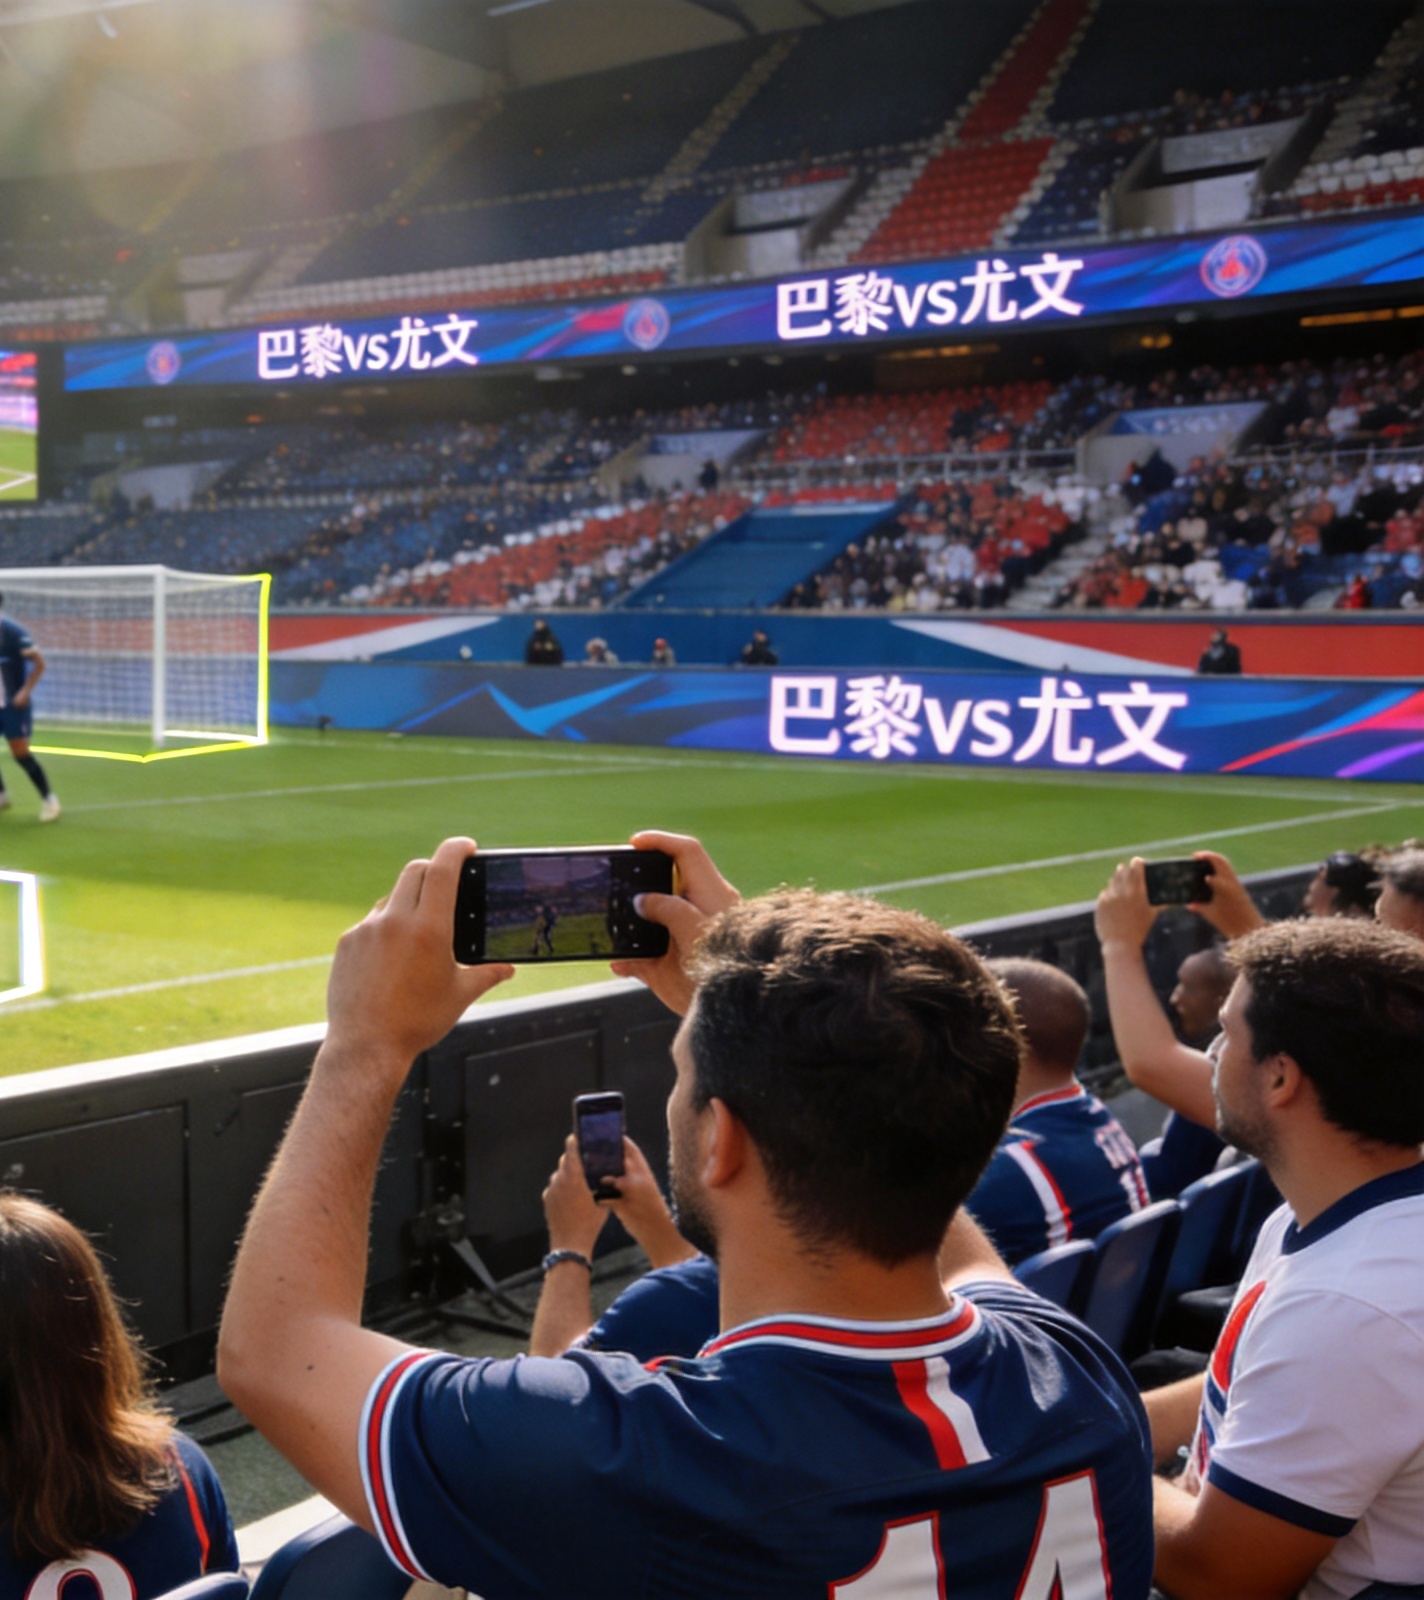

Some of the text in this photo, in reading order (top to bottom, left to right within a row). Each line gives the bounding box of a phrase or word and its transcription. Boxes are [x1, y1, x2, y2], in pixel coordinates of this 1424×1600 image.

[776, 253, 1084, 339] 巴黎vs尤文
[257, 313, 479, 380] 巴黎vs尤文
[769, 675, 1189, 770] 巴黎vs尤文
